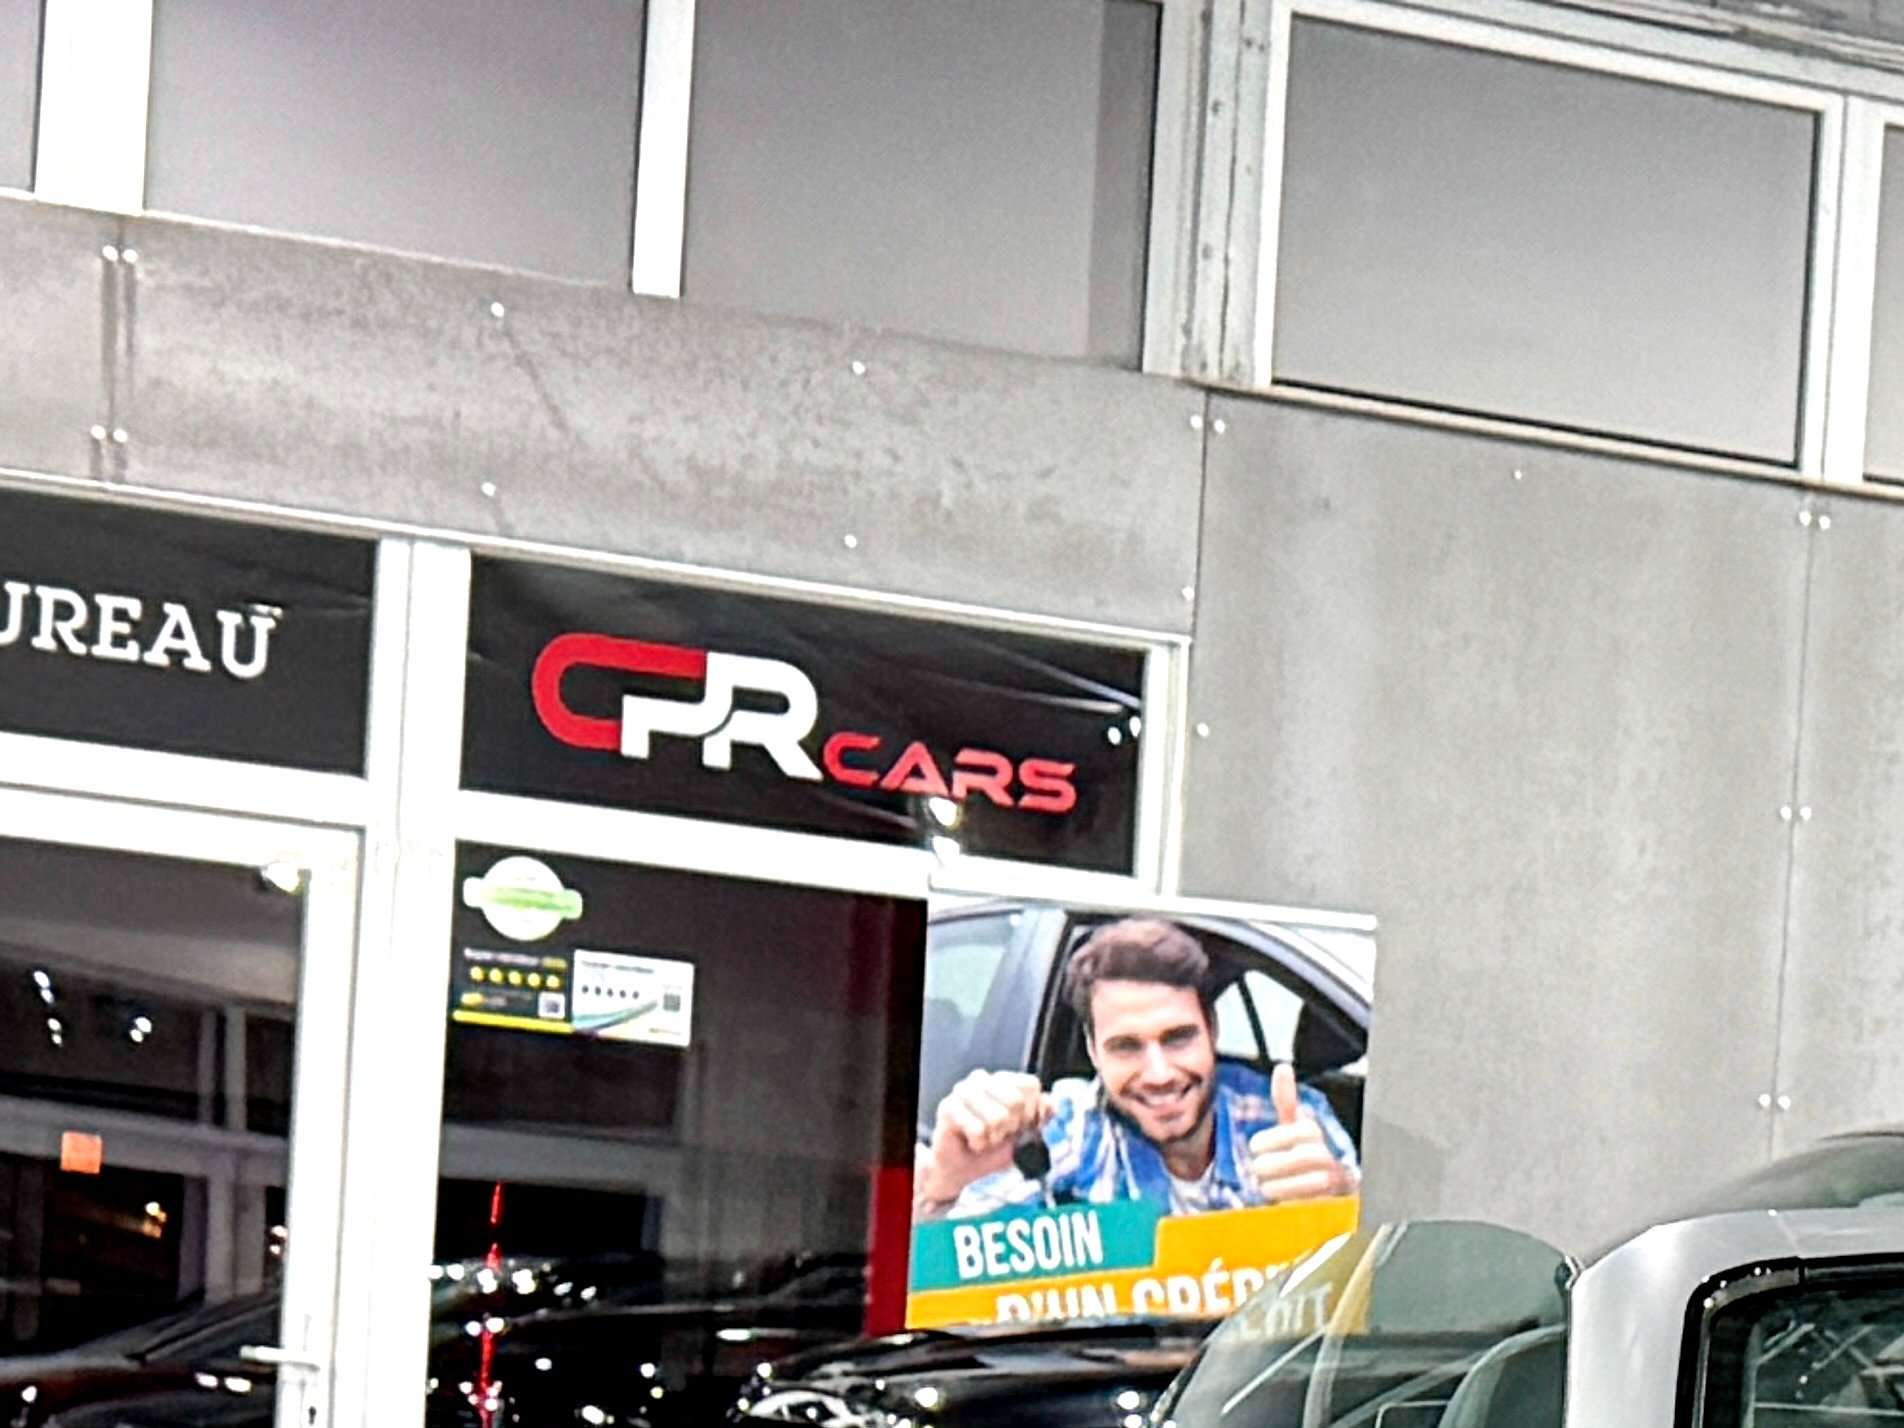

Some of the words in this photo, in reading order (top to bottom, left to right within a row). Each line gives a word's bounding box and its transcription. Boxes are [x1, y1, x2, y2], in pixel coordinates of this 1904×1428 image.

[531, 632, 823, 782] CPR
[822, 730, 1078, 814] CARS
[953, 1210, 1104, 1280] BESOIN
